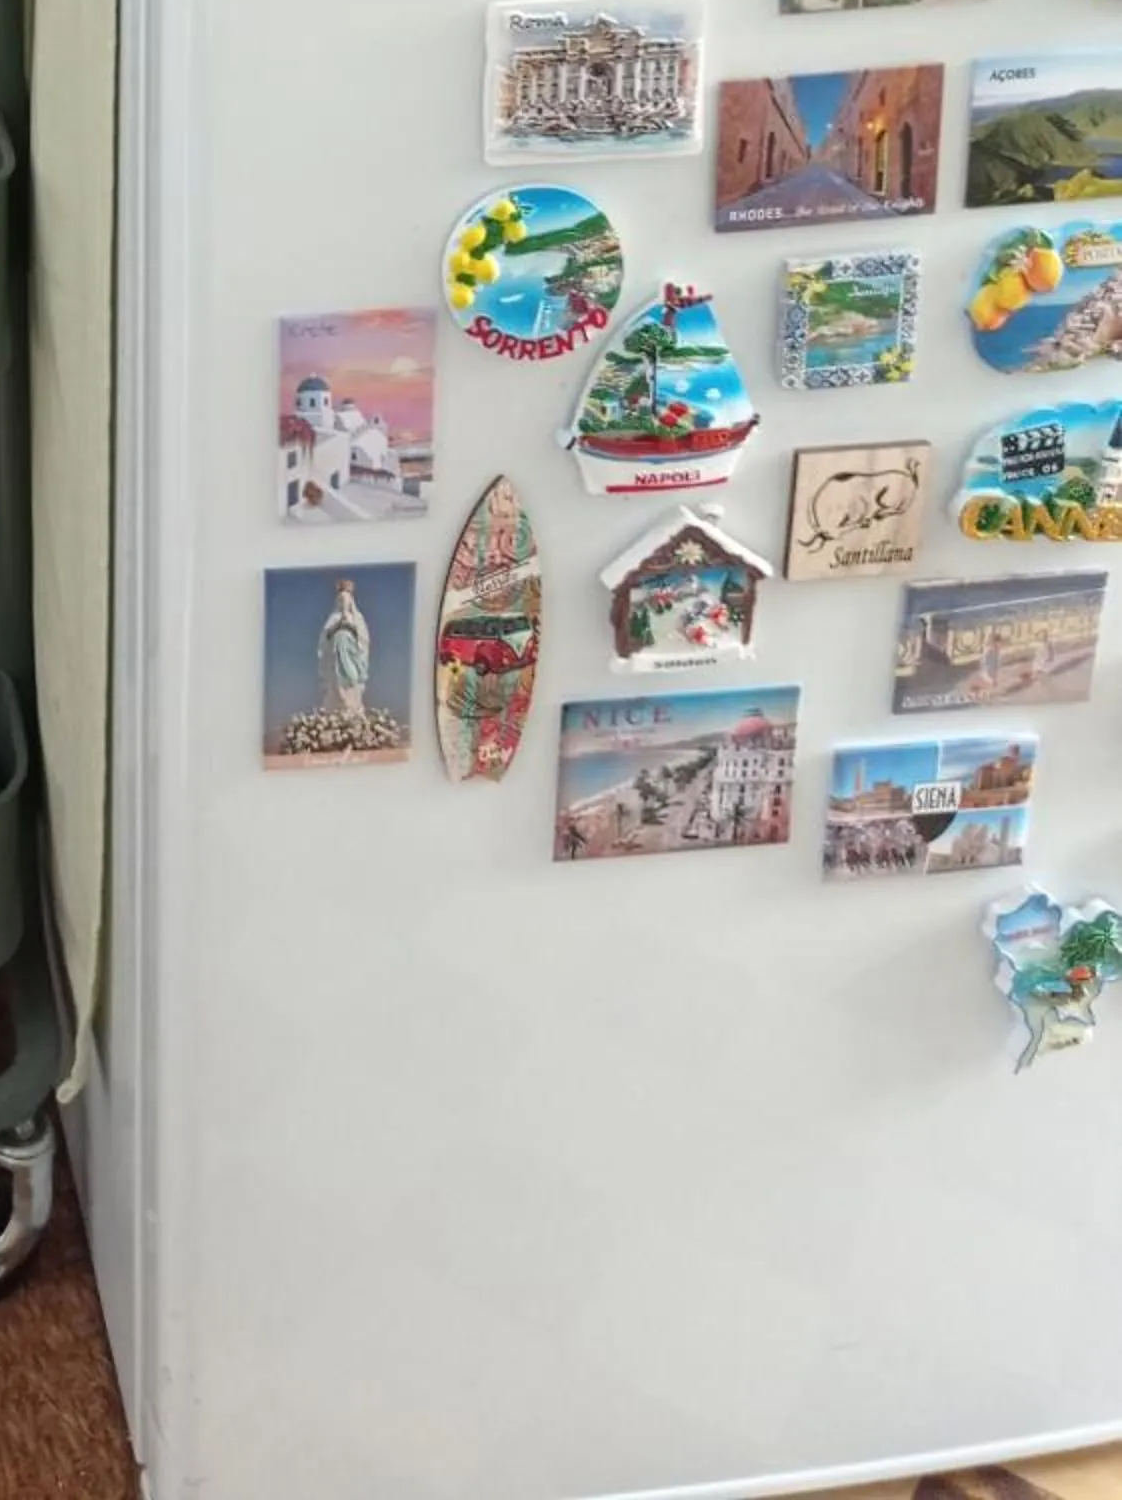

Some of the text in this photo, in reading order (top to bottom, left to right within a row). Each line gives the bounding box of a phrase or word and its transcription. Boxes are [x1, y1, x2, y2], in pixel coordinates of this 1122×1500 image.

[509, 13, 566, 33] Roma
[989, 67, 1036, 84] AÇORES
[465, 308, 608, 360] SORRENTO
[634, 470, 701, 485] NAPOLI
[582, 706, 672, 728] NICE
[917, 787, 957, 809] SIENA
